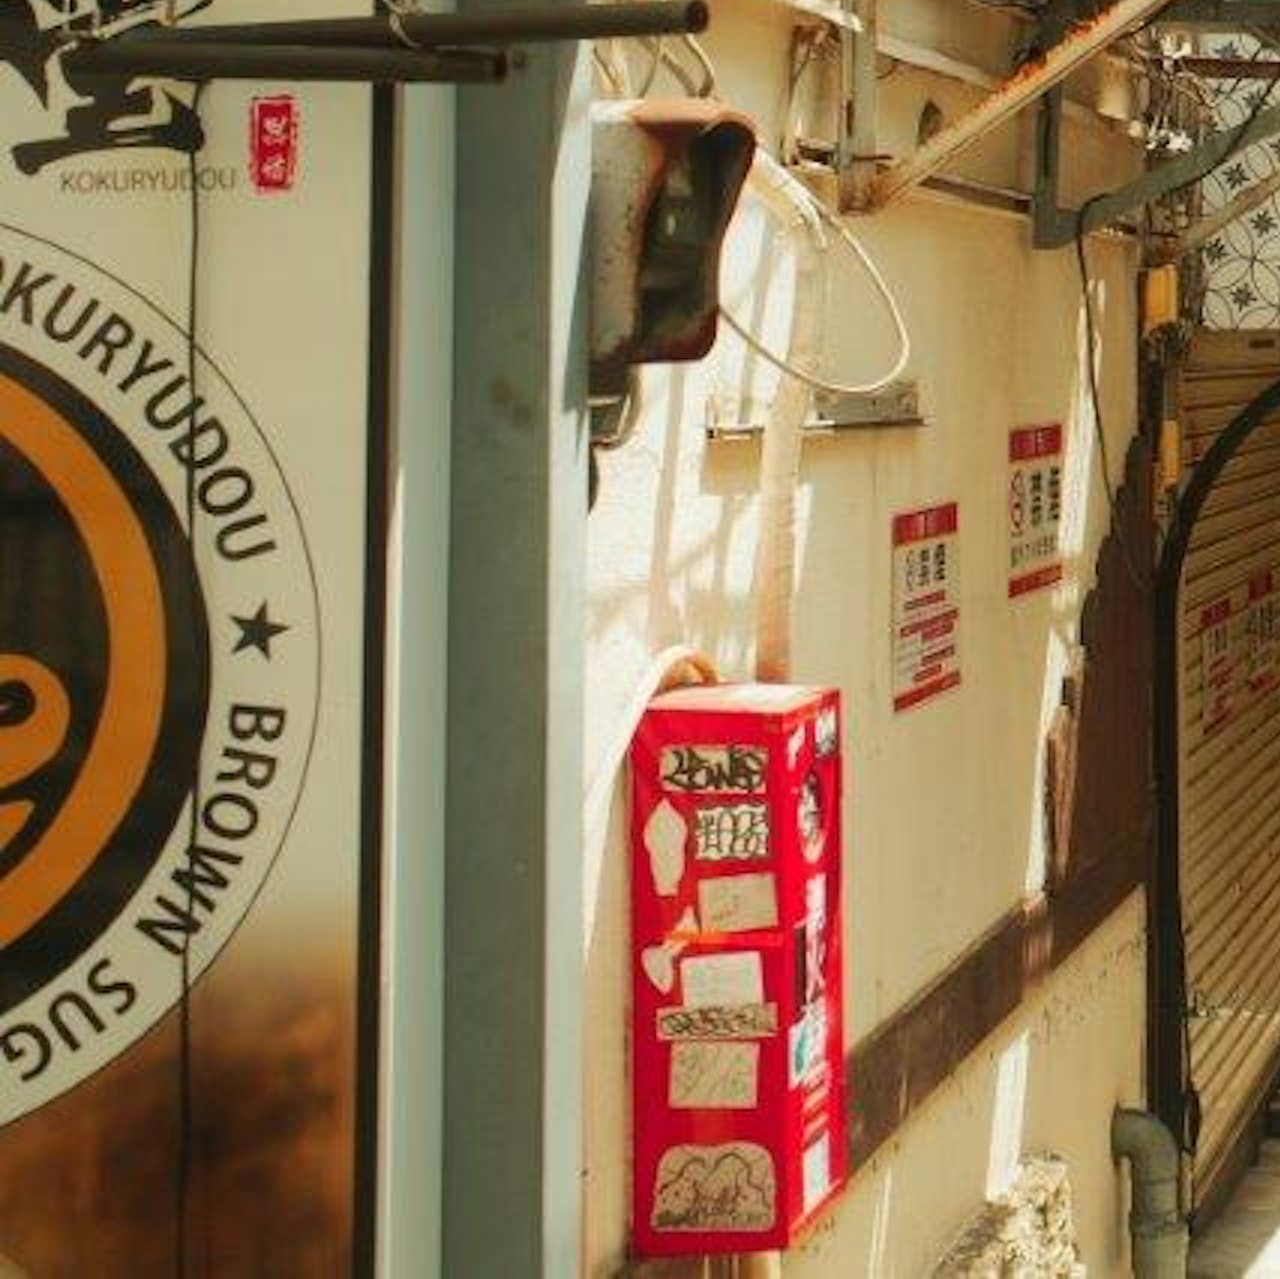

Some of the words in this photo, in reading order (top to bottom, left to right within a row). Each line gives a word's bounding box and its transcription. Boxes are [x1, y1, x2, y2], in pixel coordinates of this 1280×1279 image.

[61, 169, 236, 194] KOKURYUDOU
[0, 257, 277, 562] KURYUDOU
[136, 703, 287, 956] BROWN
